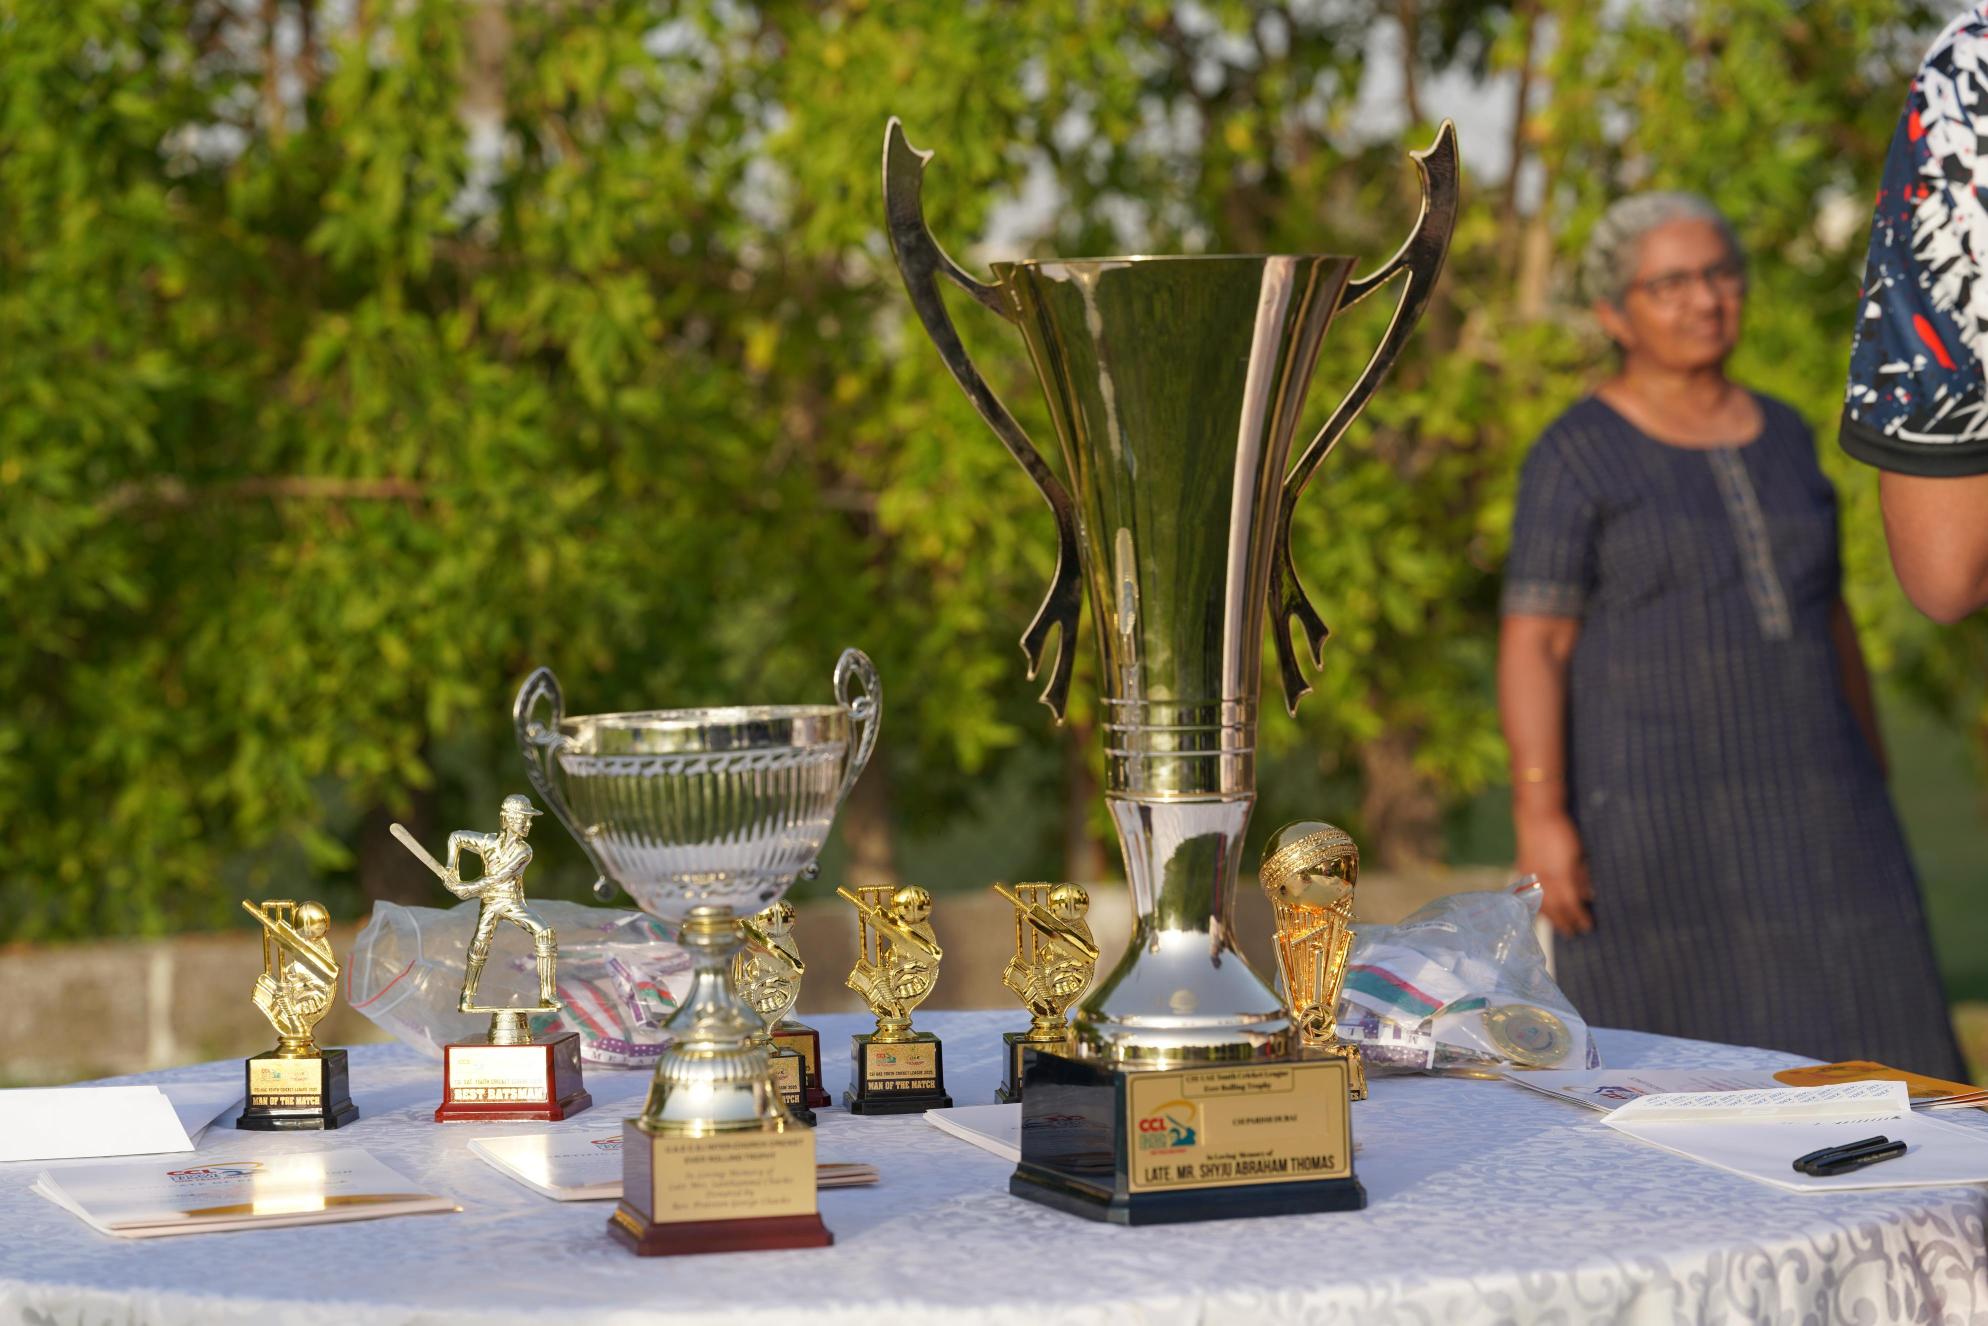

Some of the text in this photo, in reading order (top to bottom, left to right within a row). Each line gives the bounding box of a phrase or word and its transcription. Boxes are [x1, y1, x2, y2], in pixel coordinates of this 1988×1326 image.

[868, 1080, 935, 1090] MAN OF THE MATCH
[453, 1087, 545, 1100] BEST BATSMAN
[253, 1097, 320, 1105] MAN OF THE MATCH
[1139, 1118, 1168, 1133] CCL
[1177, 1165, 1197, 1180] MR.
[1235, 1158, 1287, 1176] ABRAHAM
[1291, 1155, 1335, 1172] THOMAS
